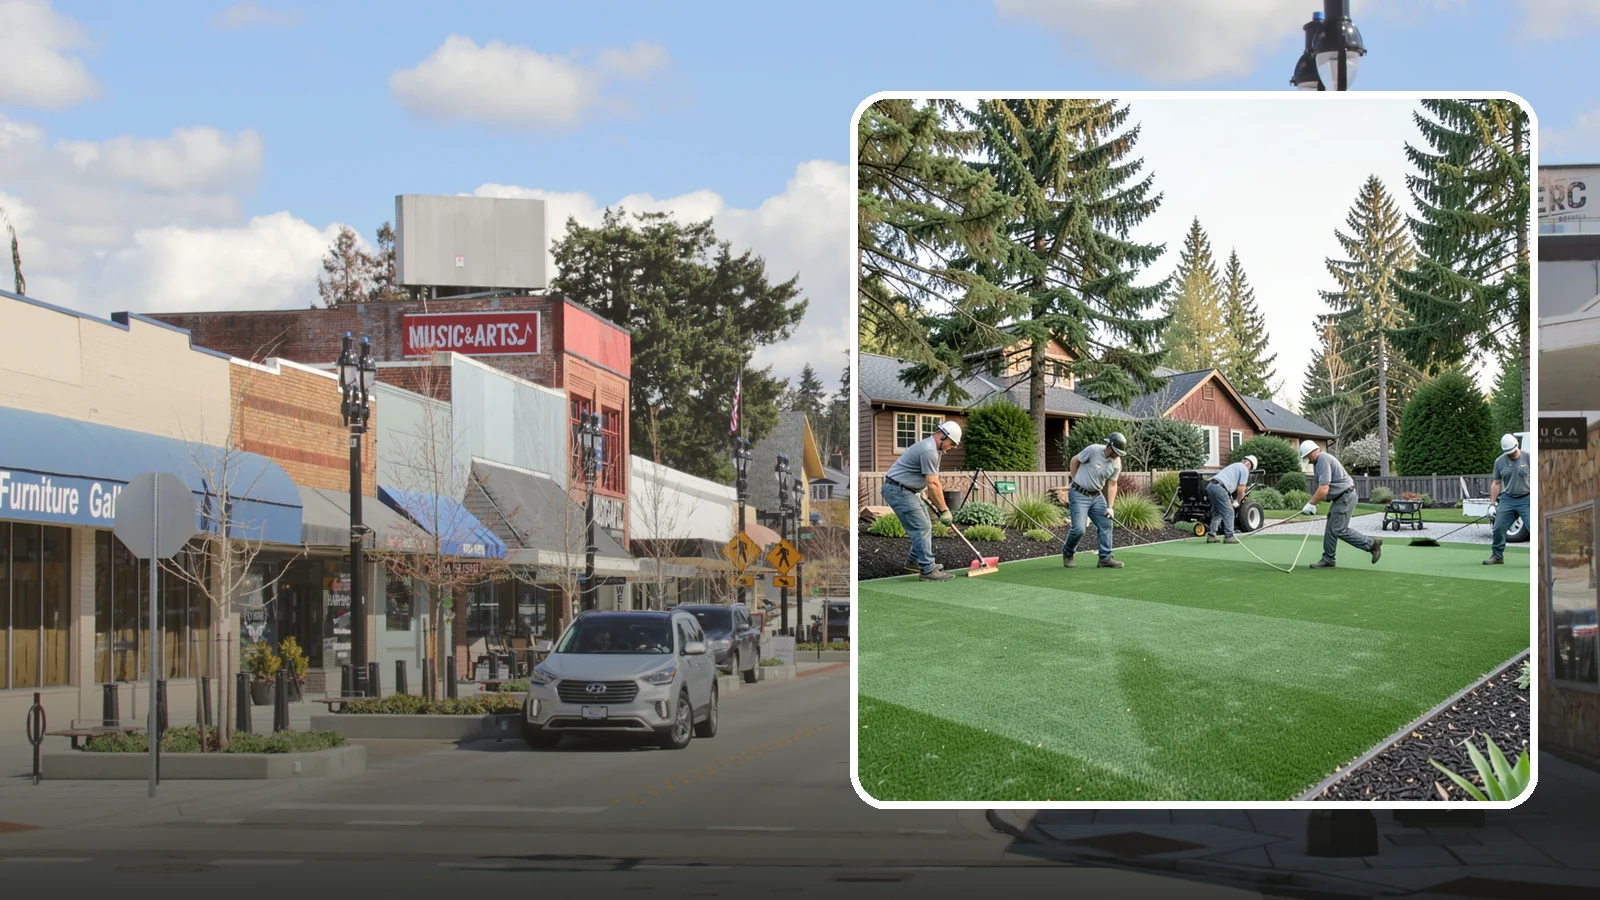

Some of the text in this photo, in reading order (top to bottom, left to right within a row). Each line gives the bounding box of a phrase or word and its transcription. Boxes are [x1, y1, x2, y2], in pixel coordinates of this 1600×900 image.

[0, 471, 122, 519] Furniture Gal
[453, 563, 479, 574] SUSHI
